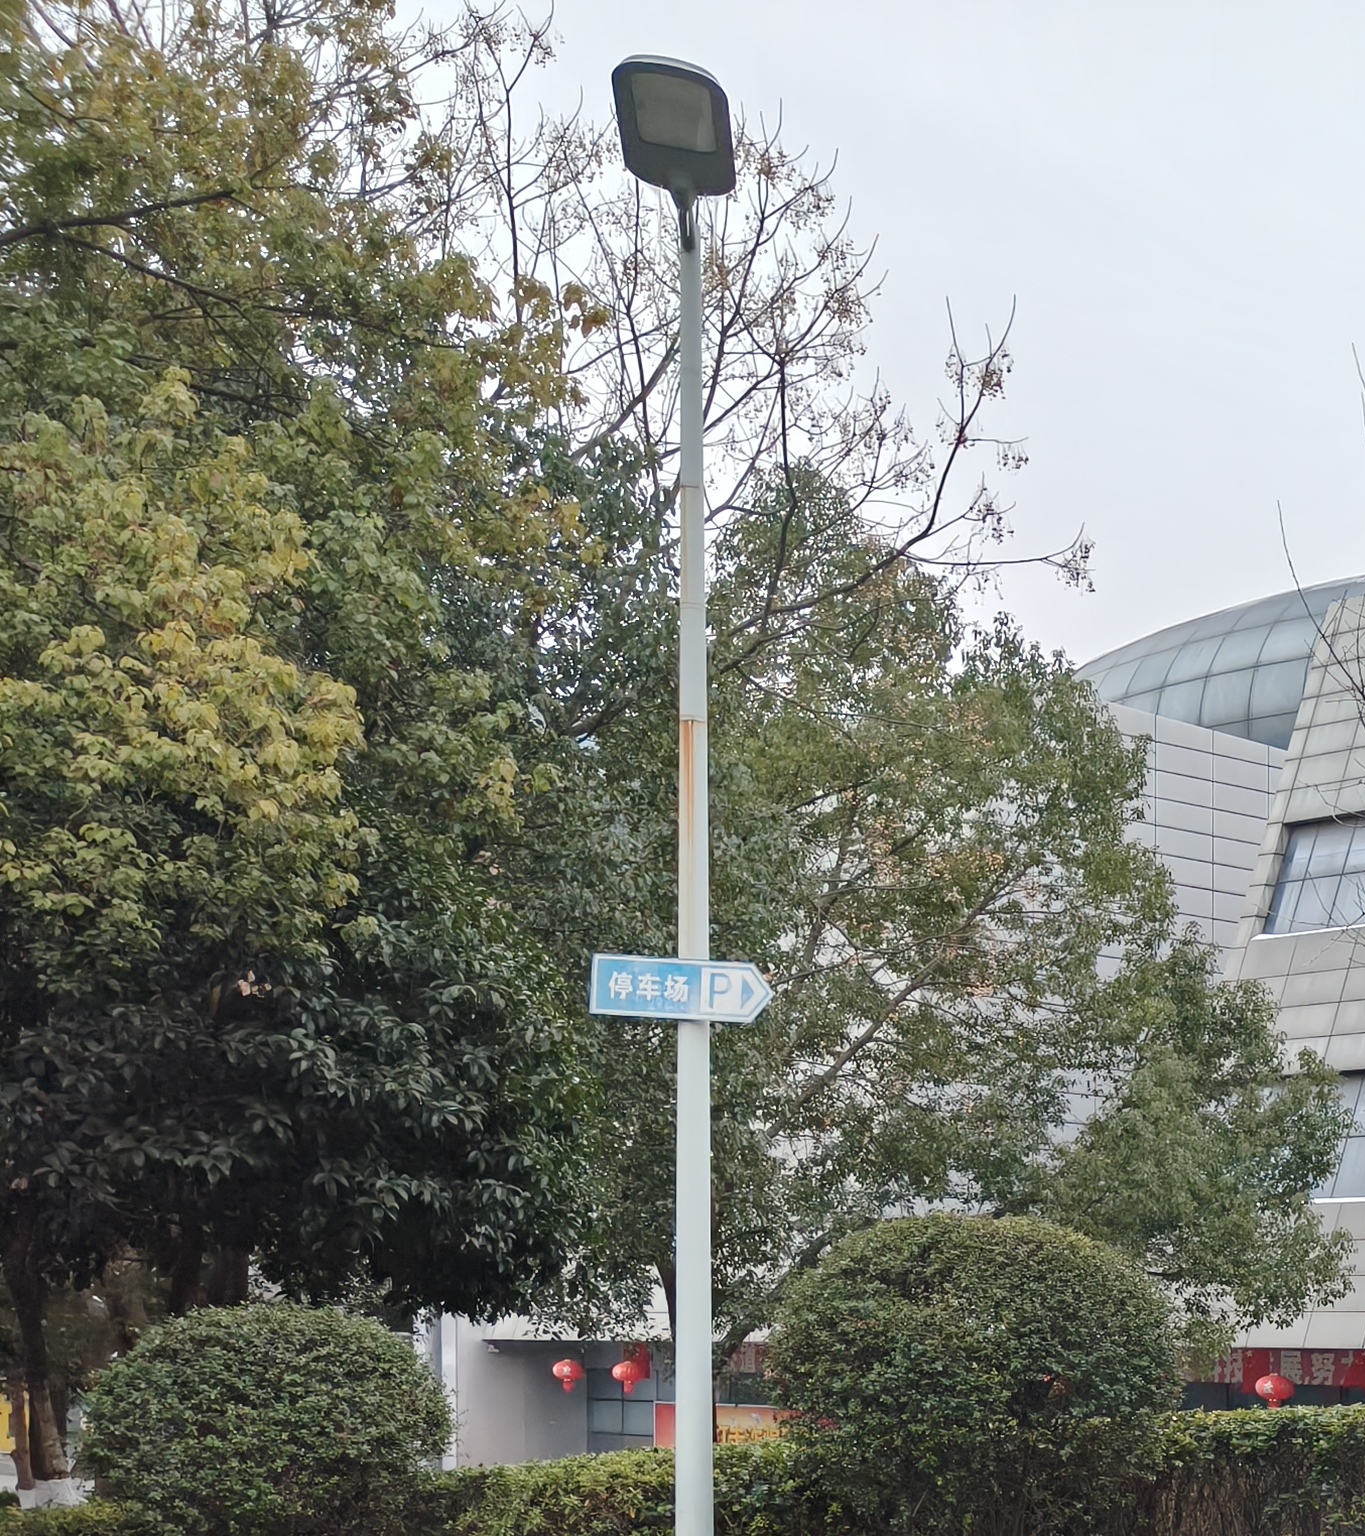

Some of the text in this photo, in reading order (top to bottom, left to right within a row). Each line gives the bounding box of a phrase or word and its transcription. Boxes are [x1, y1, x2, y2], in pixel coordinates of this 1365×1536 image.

[608, 971, 732, 1009] 停车场 P
